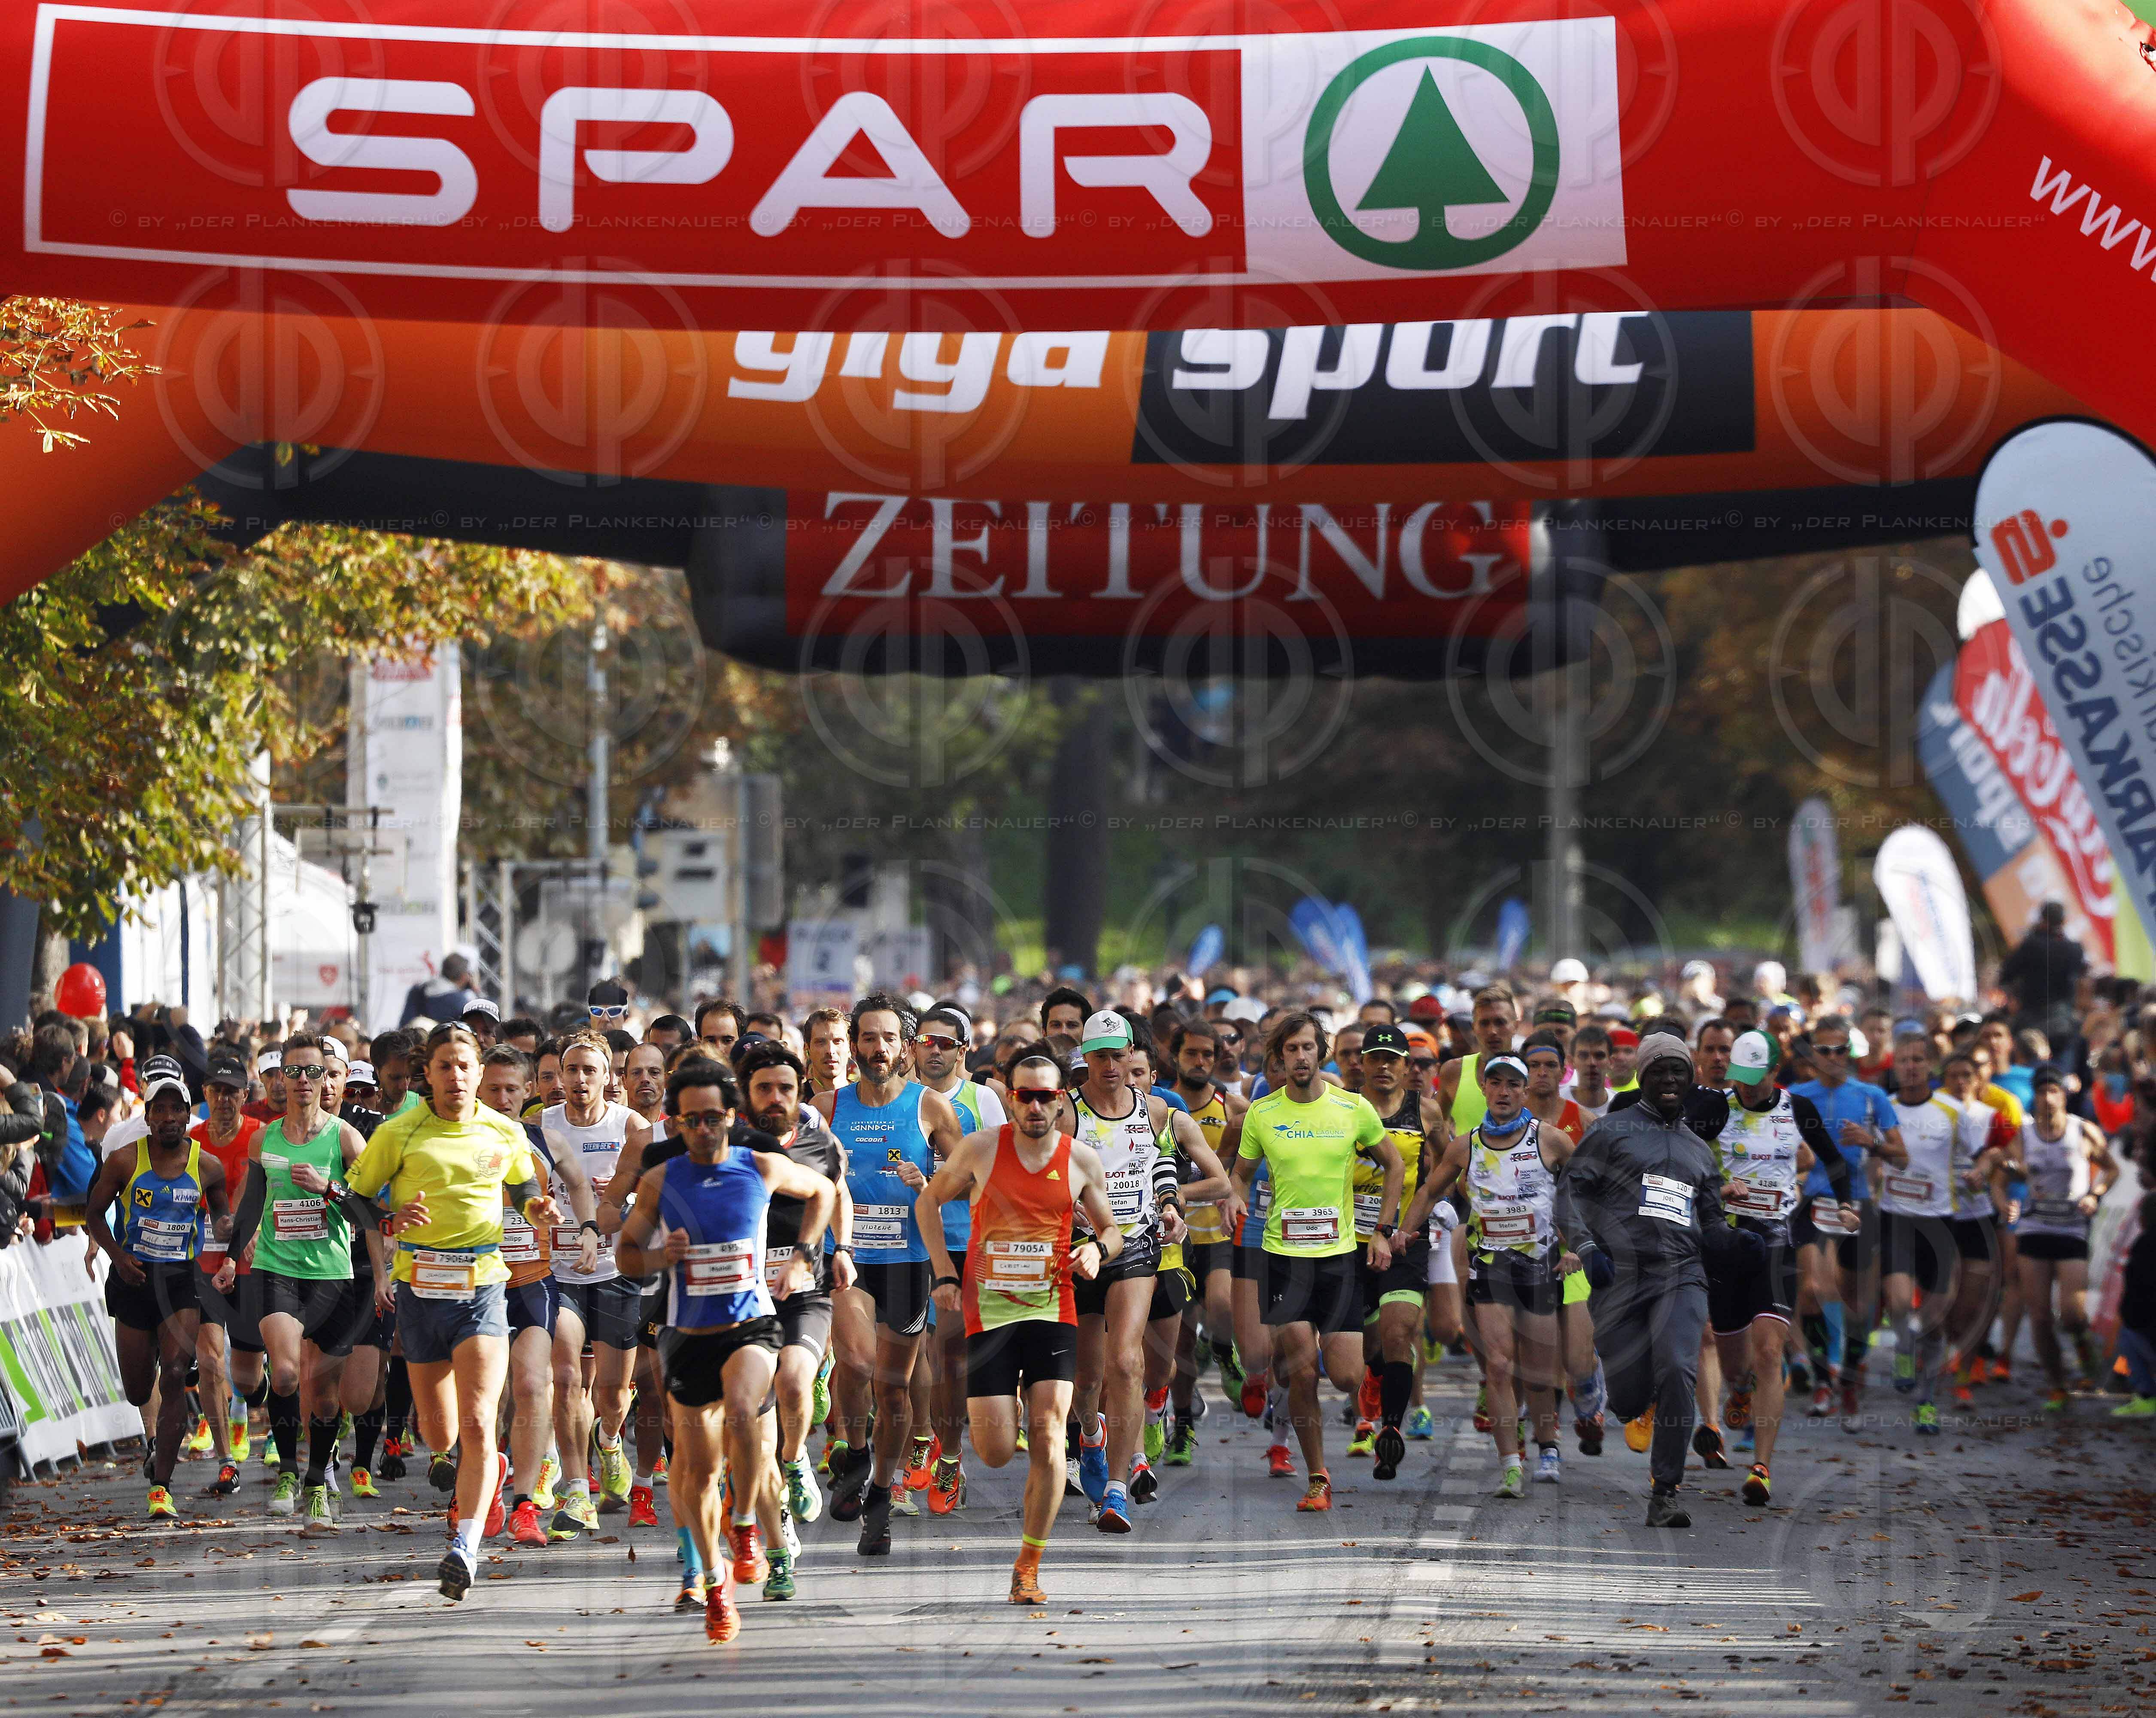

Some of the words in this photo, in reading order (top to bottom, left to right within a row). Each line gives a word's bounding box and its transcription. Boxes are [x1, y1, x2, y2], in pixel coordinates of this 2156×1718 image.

[285, 76, 1213, 239] SPAR
[820, 492, 1500, 602] ZEITUNG
[1330, 1098, 1354, 1110] DIADORA
[1114, 1180, 1139, 1189] 20018
[1676, 1183, 1687, 1192] 120
[175, 1193, 197, 1202] KPMG
[1506, 1206, 1526, 1214] 3983
